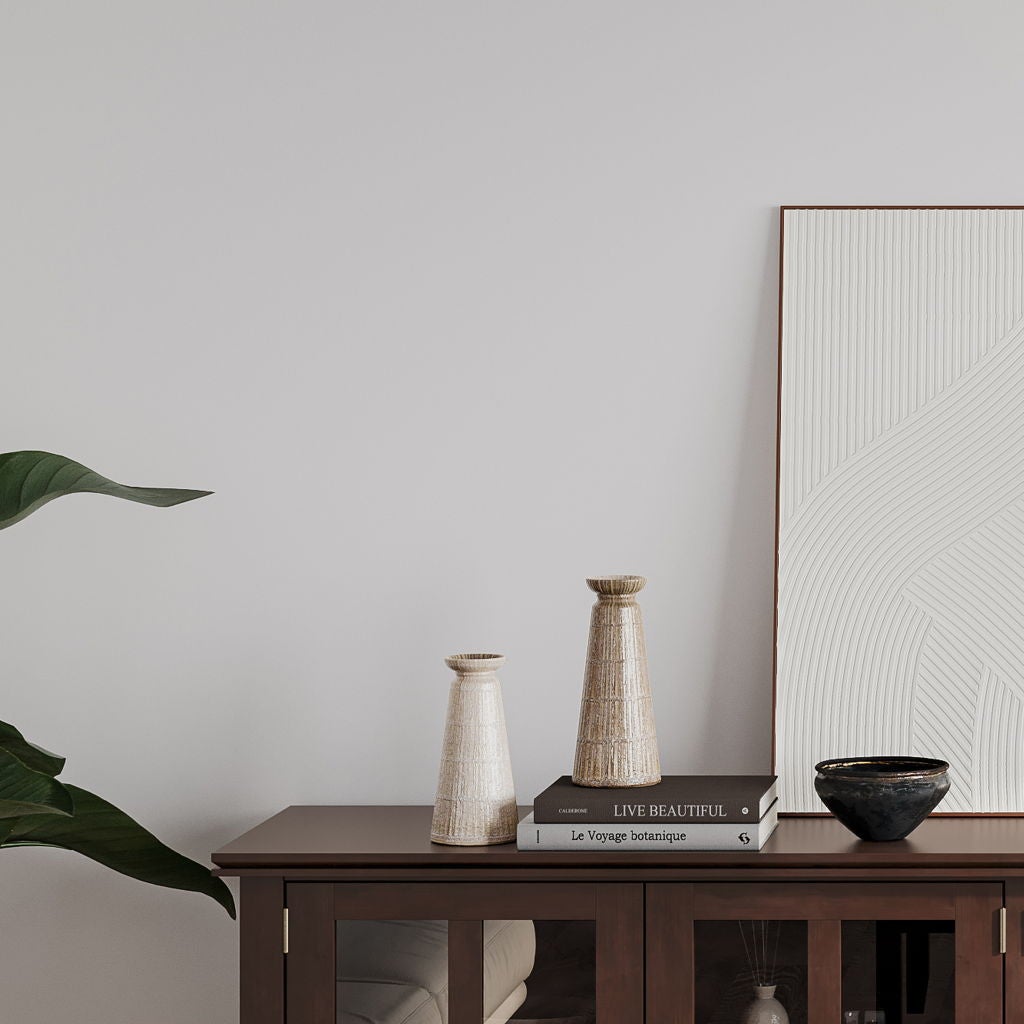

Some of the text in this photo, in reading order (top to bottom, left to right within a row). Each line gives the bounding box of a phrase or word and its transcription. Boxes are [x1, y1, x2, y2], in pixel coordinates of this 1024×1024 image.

[614, 805, 646, 817] LIVE
[649, 805, 727, 817] BEAUTIFUL
[571, 830, 687, 844] Le Voyage botanique
